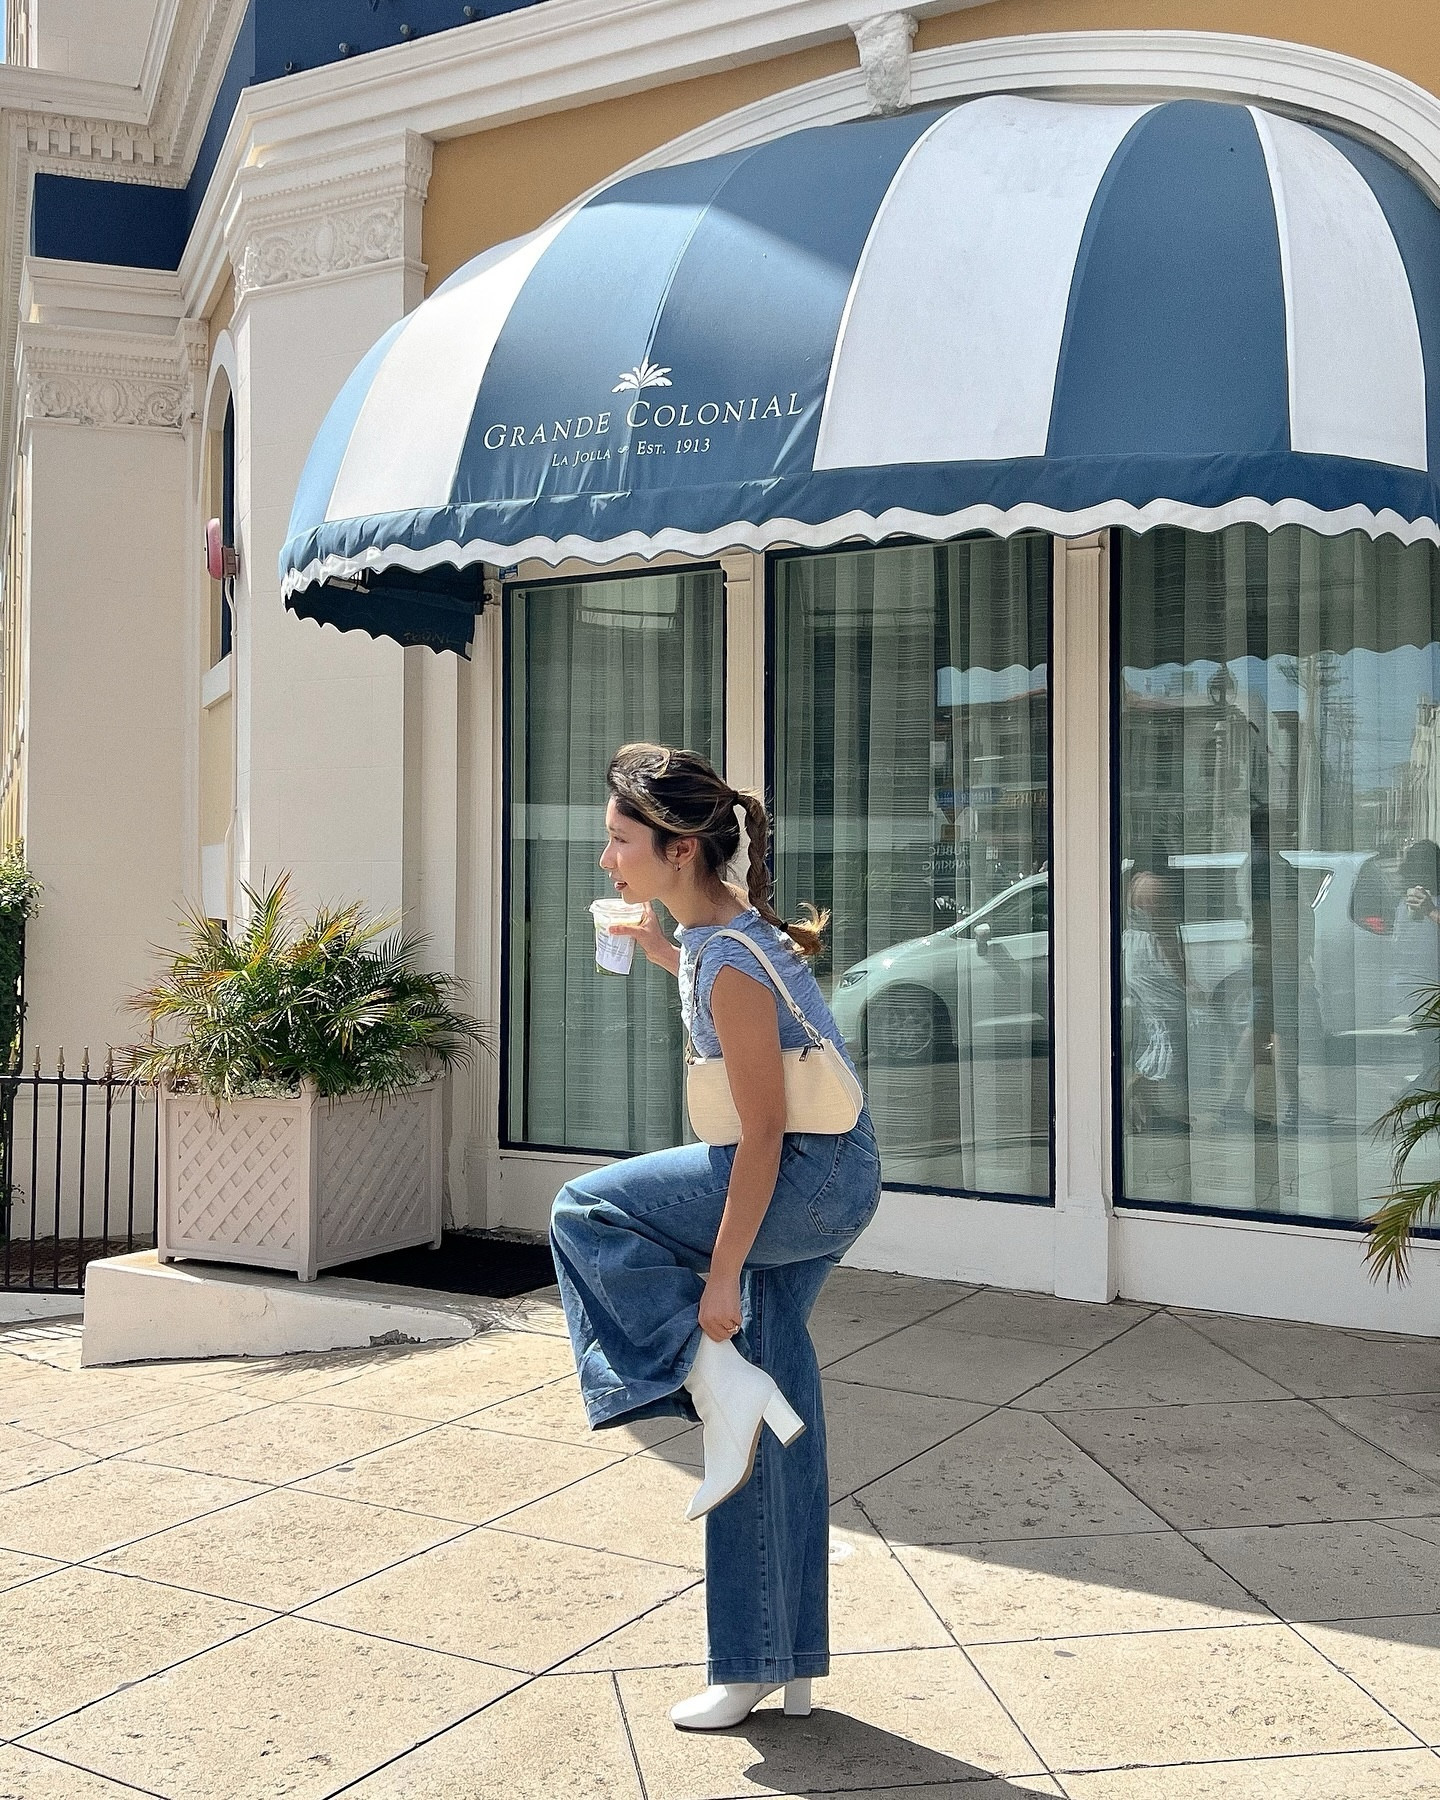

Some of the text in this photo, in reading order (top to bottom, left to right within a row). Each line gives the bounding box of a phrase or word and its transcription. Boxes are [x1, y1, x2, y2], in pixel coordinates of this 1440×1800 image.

[483, 392, 804, 450] GRANDE COLONIAL
[552, 438, 711, 467] LA JOLLA EST. 1913
